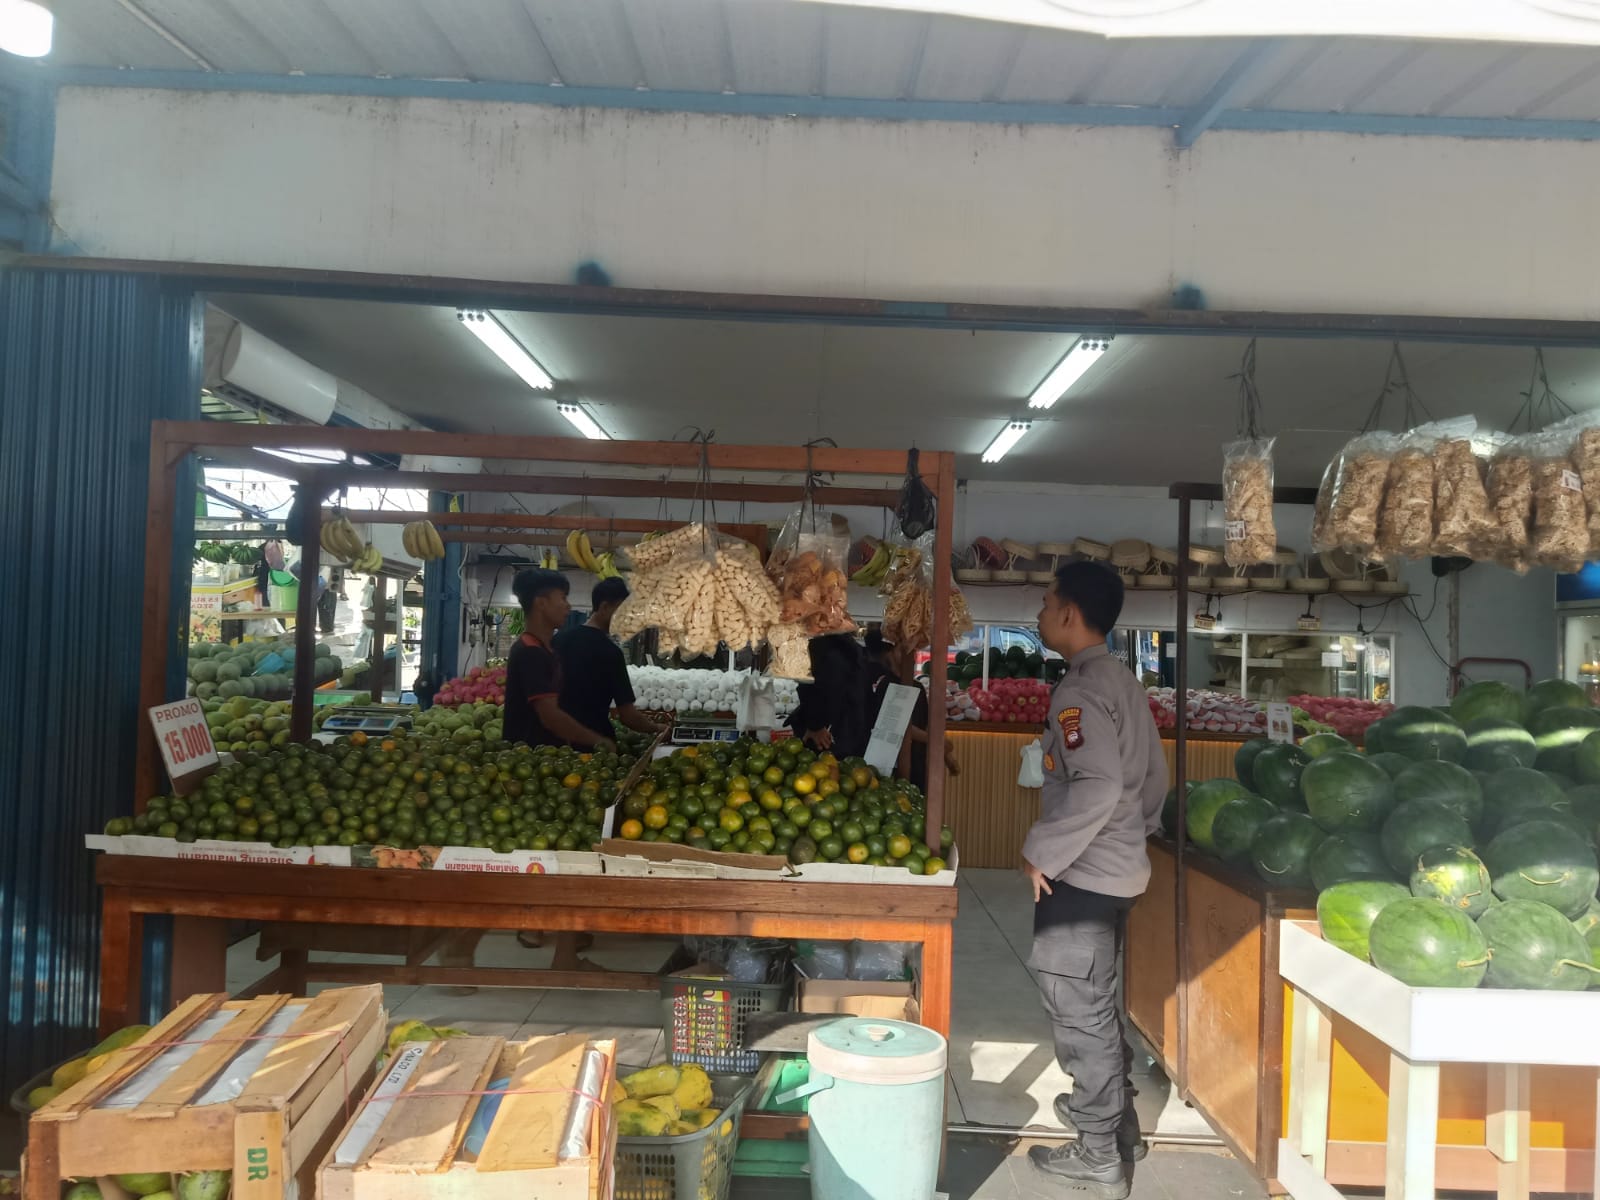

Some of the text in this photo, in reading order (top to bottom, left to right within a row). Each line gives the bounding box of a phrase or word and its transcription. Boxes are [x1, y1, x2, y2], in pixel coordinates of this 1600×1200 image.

[155, 703, 199, 722] PROMO
[165, 723, 212, 765] 15.000
[247, 1147, 269, 1181] DR
